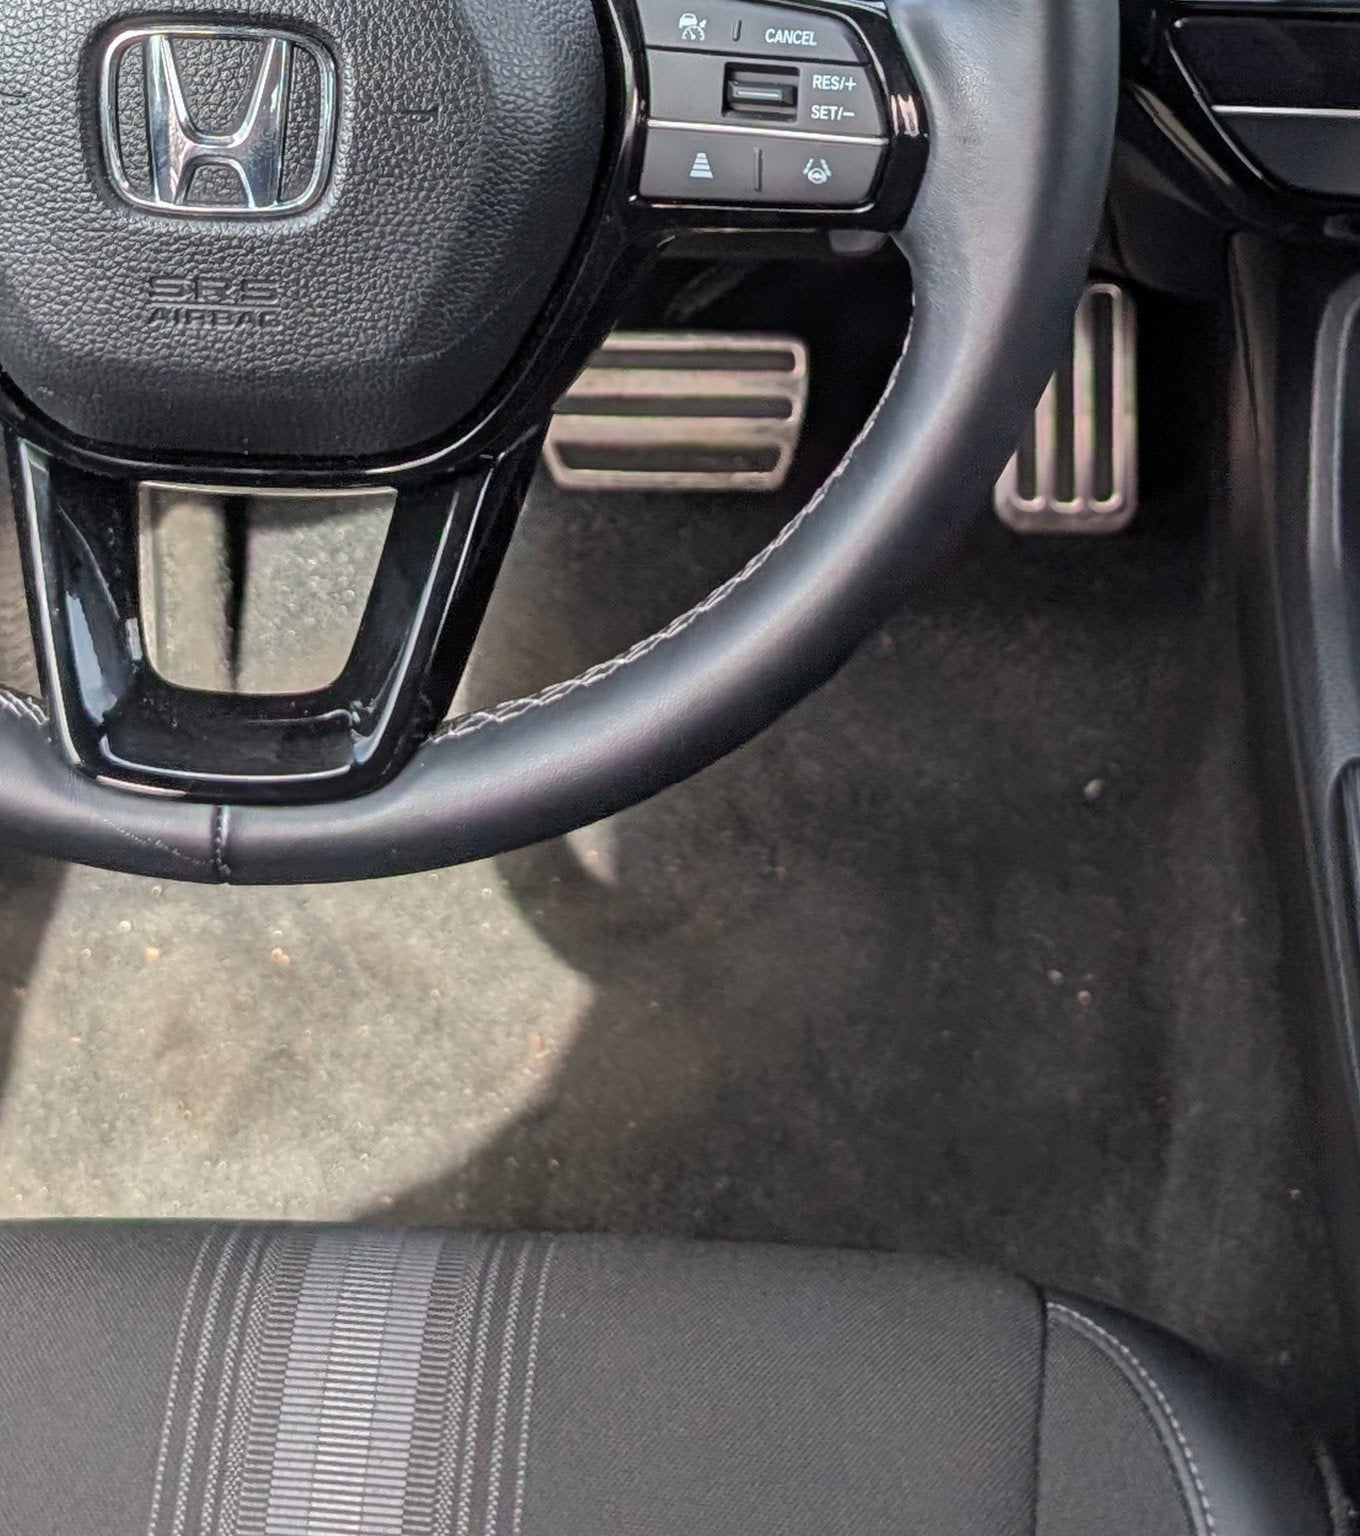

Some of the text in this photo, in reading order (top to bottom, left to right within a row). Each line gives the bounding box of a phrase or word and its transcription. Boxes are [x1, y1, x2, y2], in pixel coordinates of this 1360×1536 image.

[765, 28, 818, 47] CANCEL
[812, 75, 857, 92] RES/+
[811, 105, 856, 121] SET/-
